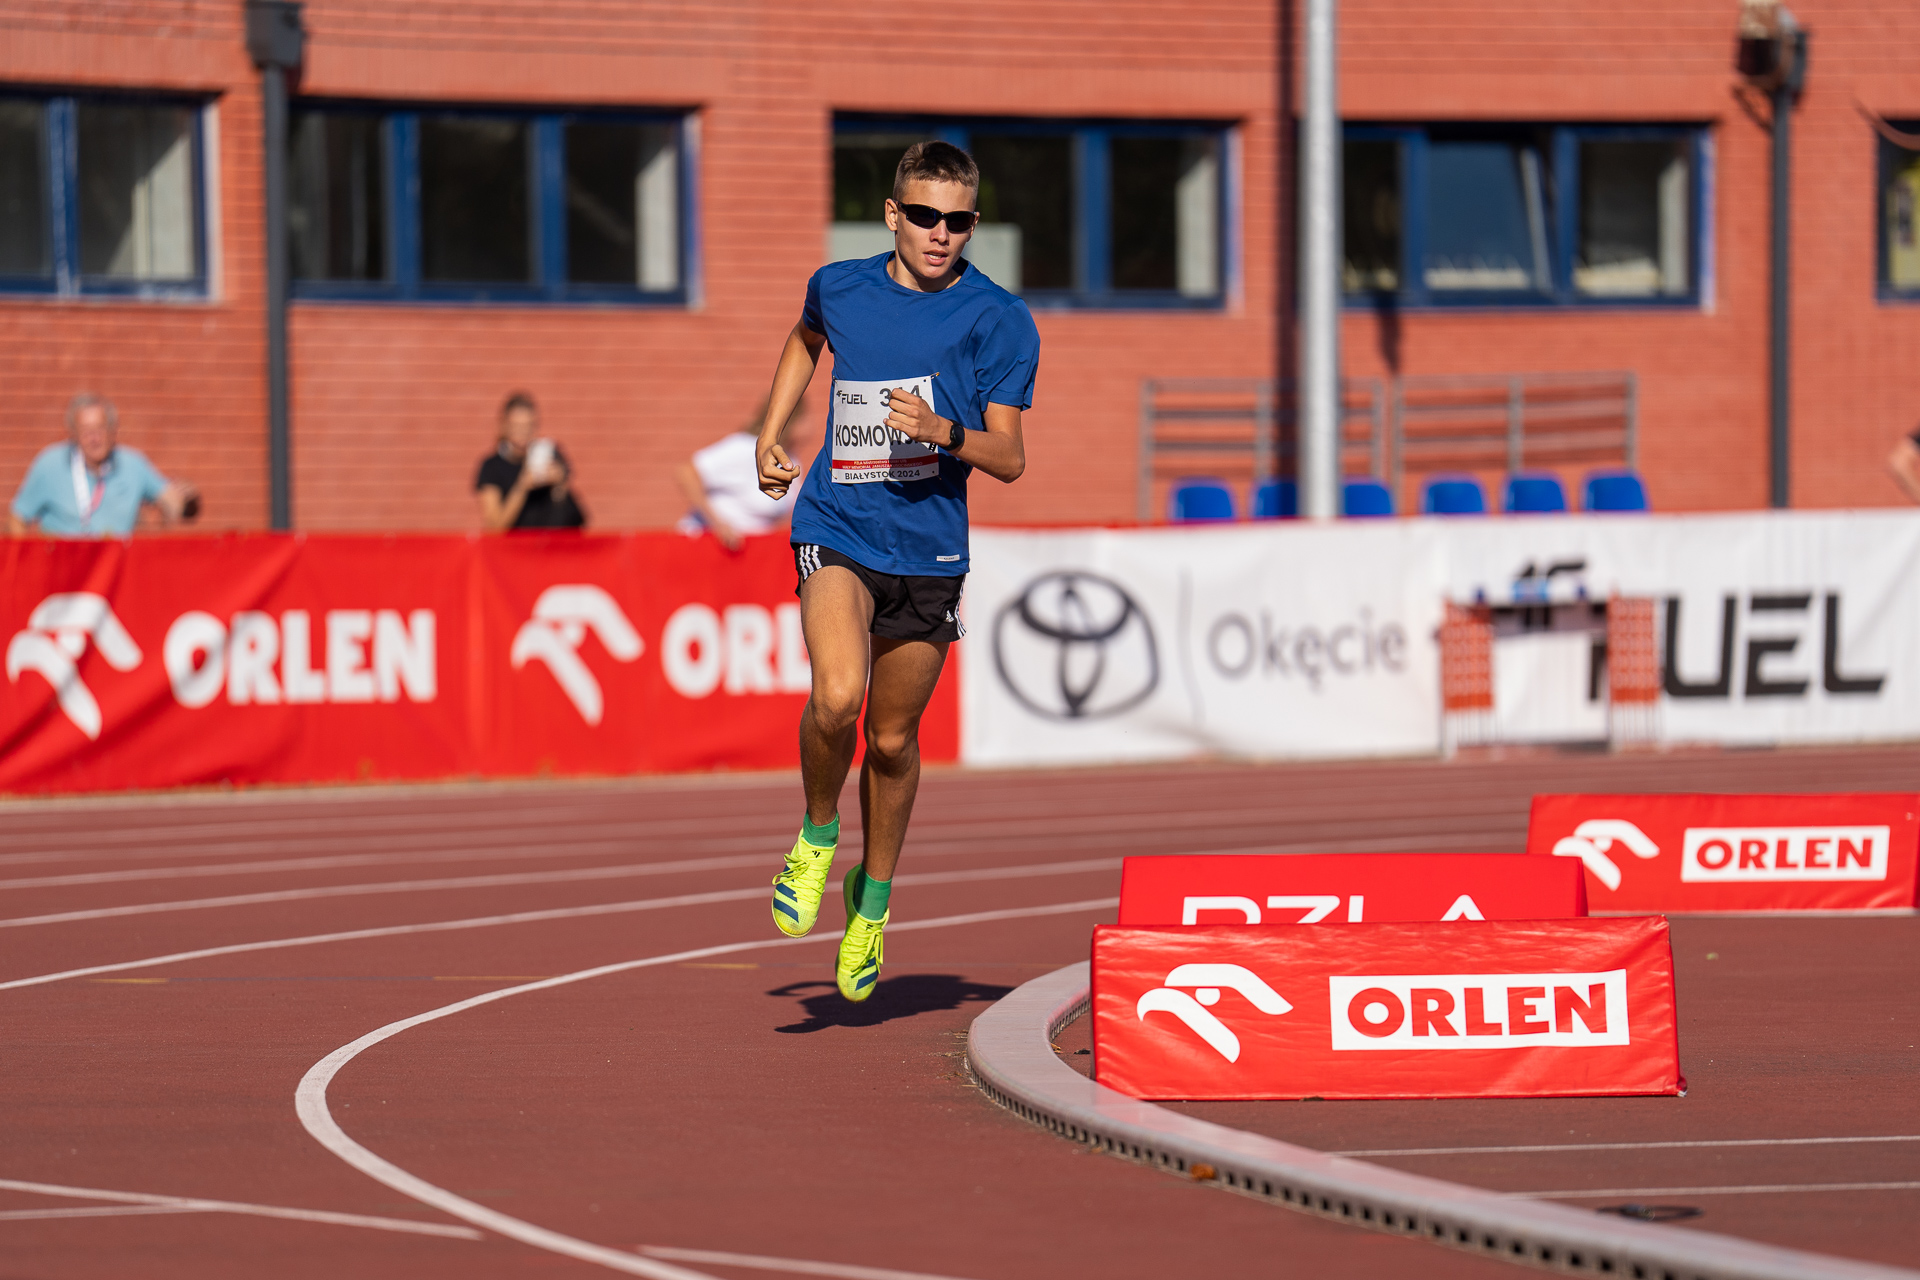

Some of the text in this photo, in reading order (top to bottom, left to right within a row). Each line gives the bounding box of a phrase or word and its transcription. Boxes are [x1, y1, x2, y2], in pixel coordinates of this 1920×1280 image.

[842, 394, 867, 404] FUEL
[879, 385, 922, 407] 34
[835, 424, 921, 447] KOSMOW
[845, 469, 920, 480] BIAŁYSTOK 2024
[164, 609, 437, 709] ORLEN
[660, 602, 813, 699] ORL
[1696, 838, 1873, 870] ORLEN
[1347, 983, 1608, 1038] ORLEN
